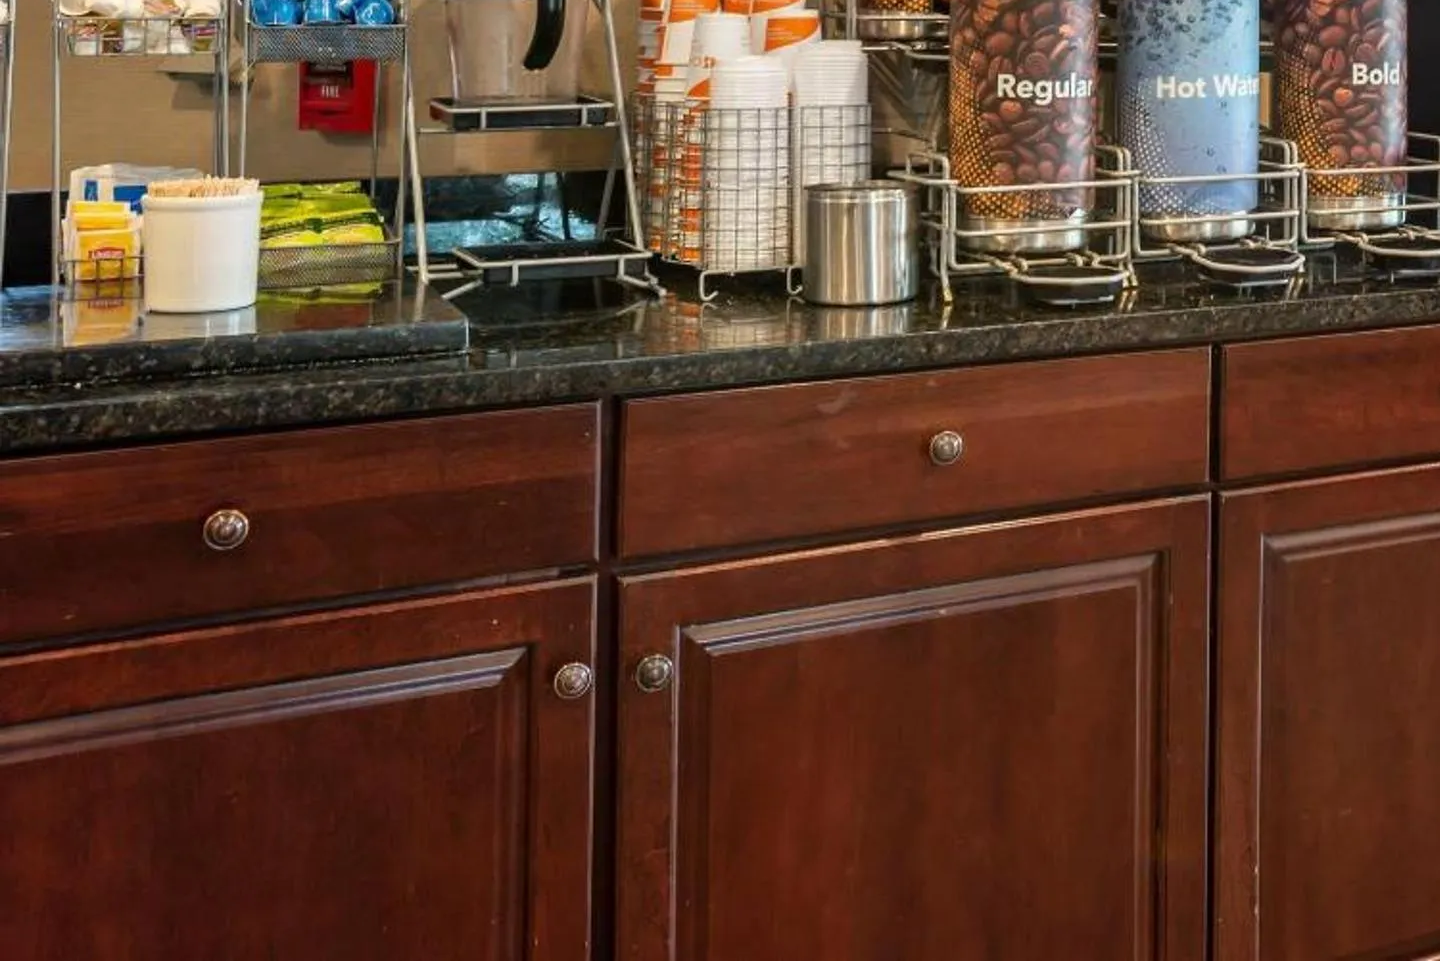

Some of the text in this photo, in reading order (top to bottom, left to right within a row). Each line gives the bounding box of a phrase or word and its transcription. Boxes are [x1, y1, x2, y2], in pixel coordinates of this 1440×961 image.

[1352, 61, 1400, 86] Bold
[997, 72, 1093, 106] Regular
[1156, 75, 1207, 99] Hot
